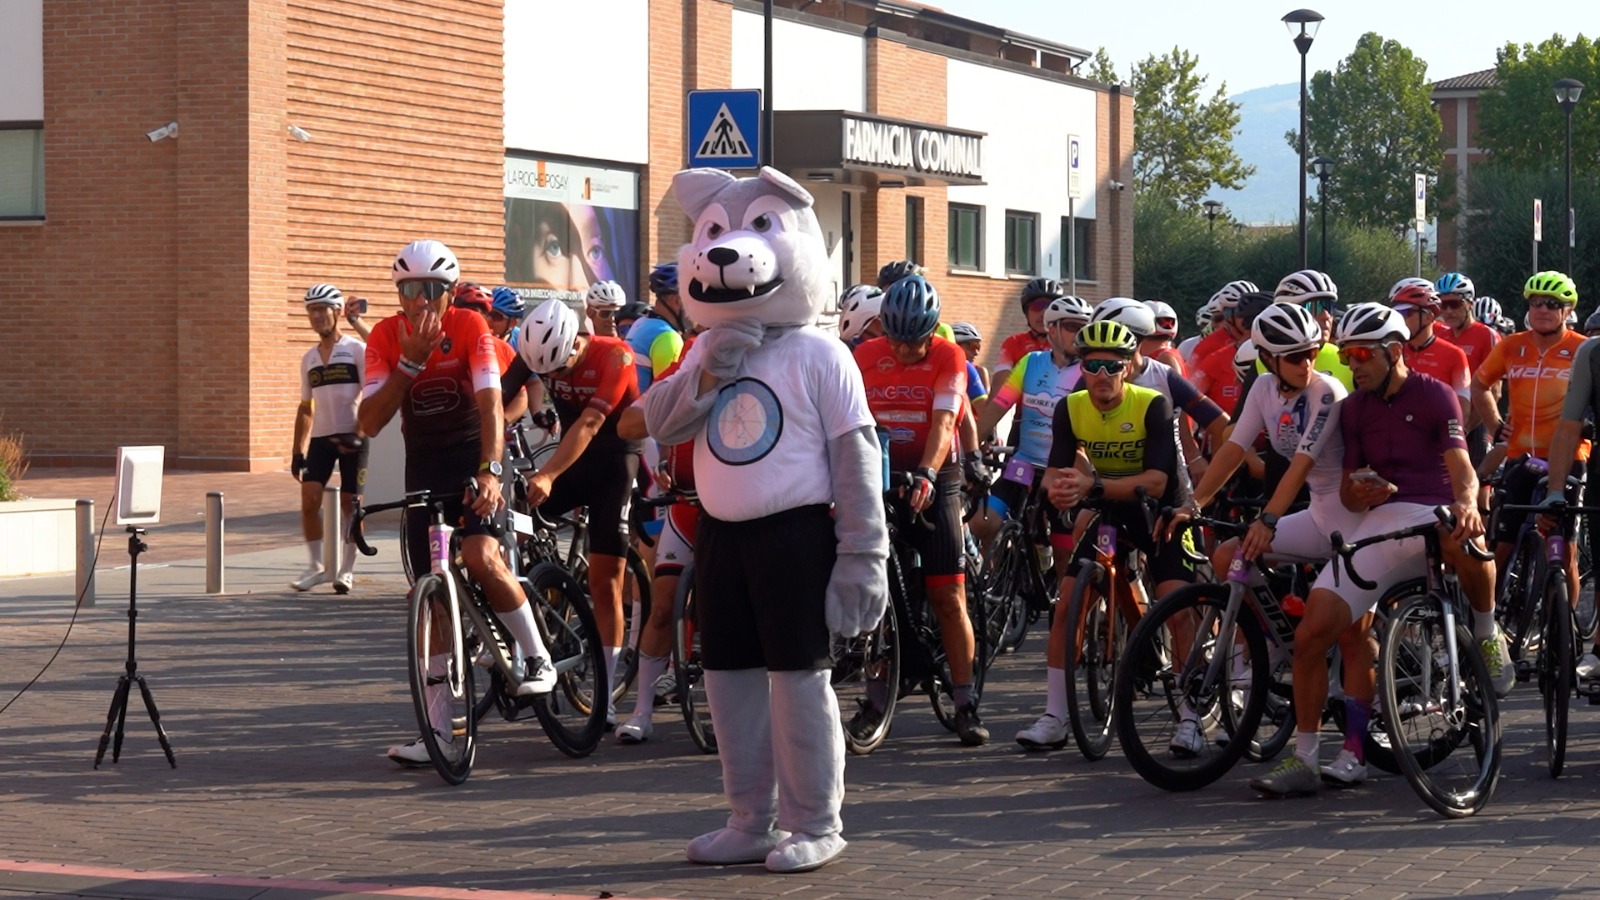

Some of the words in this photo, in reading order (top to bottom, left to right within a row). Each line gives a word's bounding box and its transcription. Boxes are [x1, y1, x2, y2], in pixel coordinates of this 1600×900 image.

[844, 117, 914, 168] FARMACIA
[1071, 143, 1078, 166] P
[1016, 467, 1025, 477] 8
[1098, 534, 1110, 546] 10
[1551, 543, 1558, 555] 1
